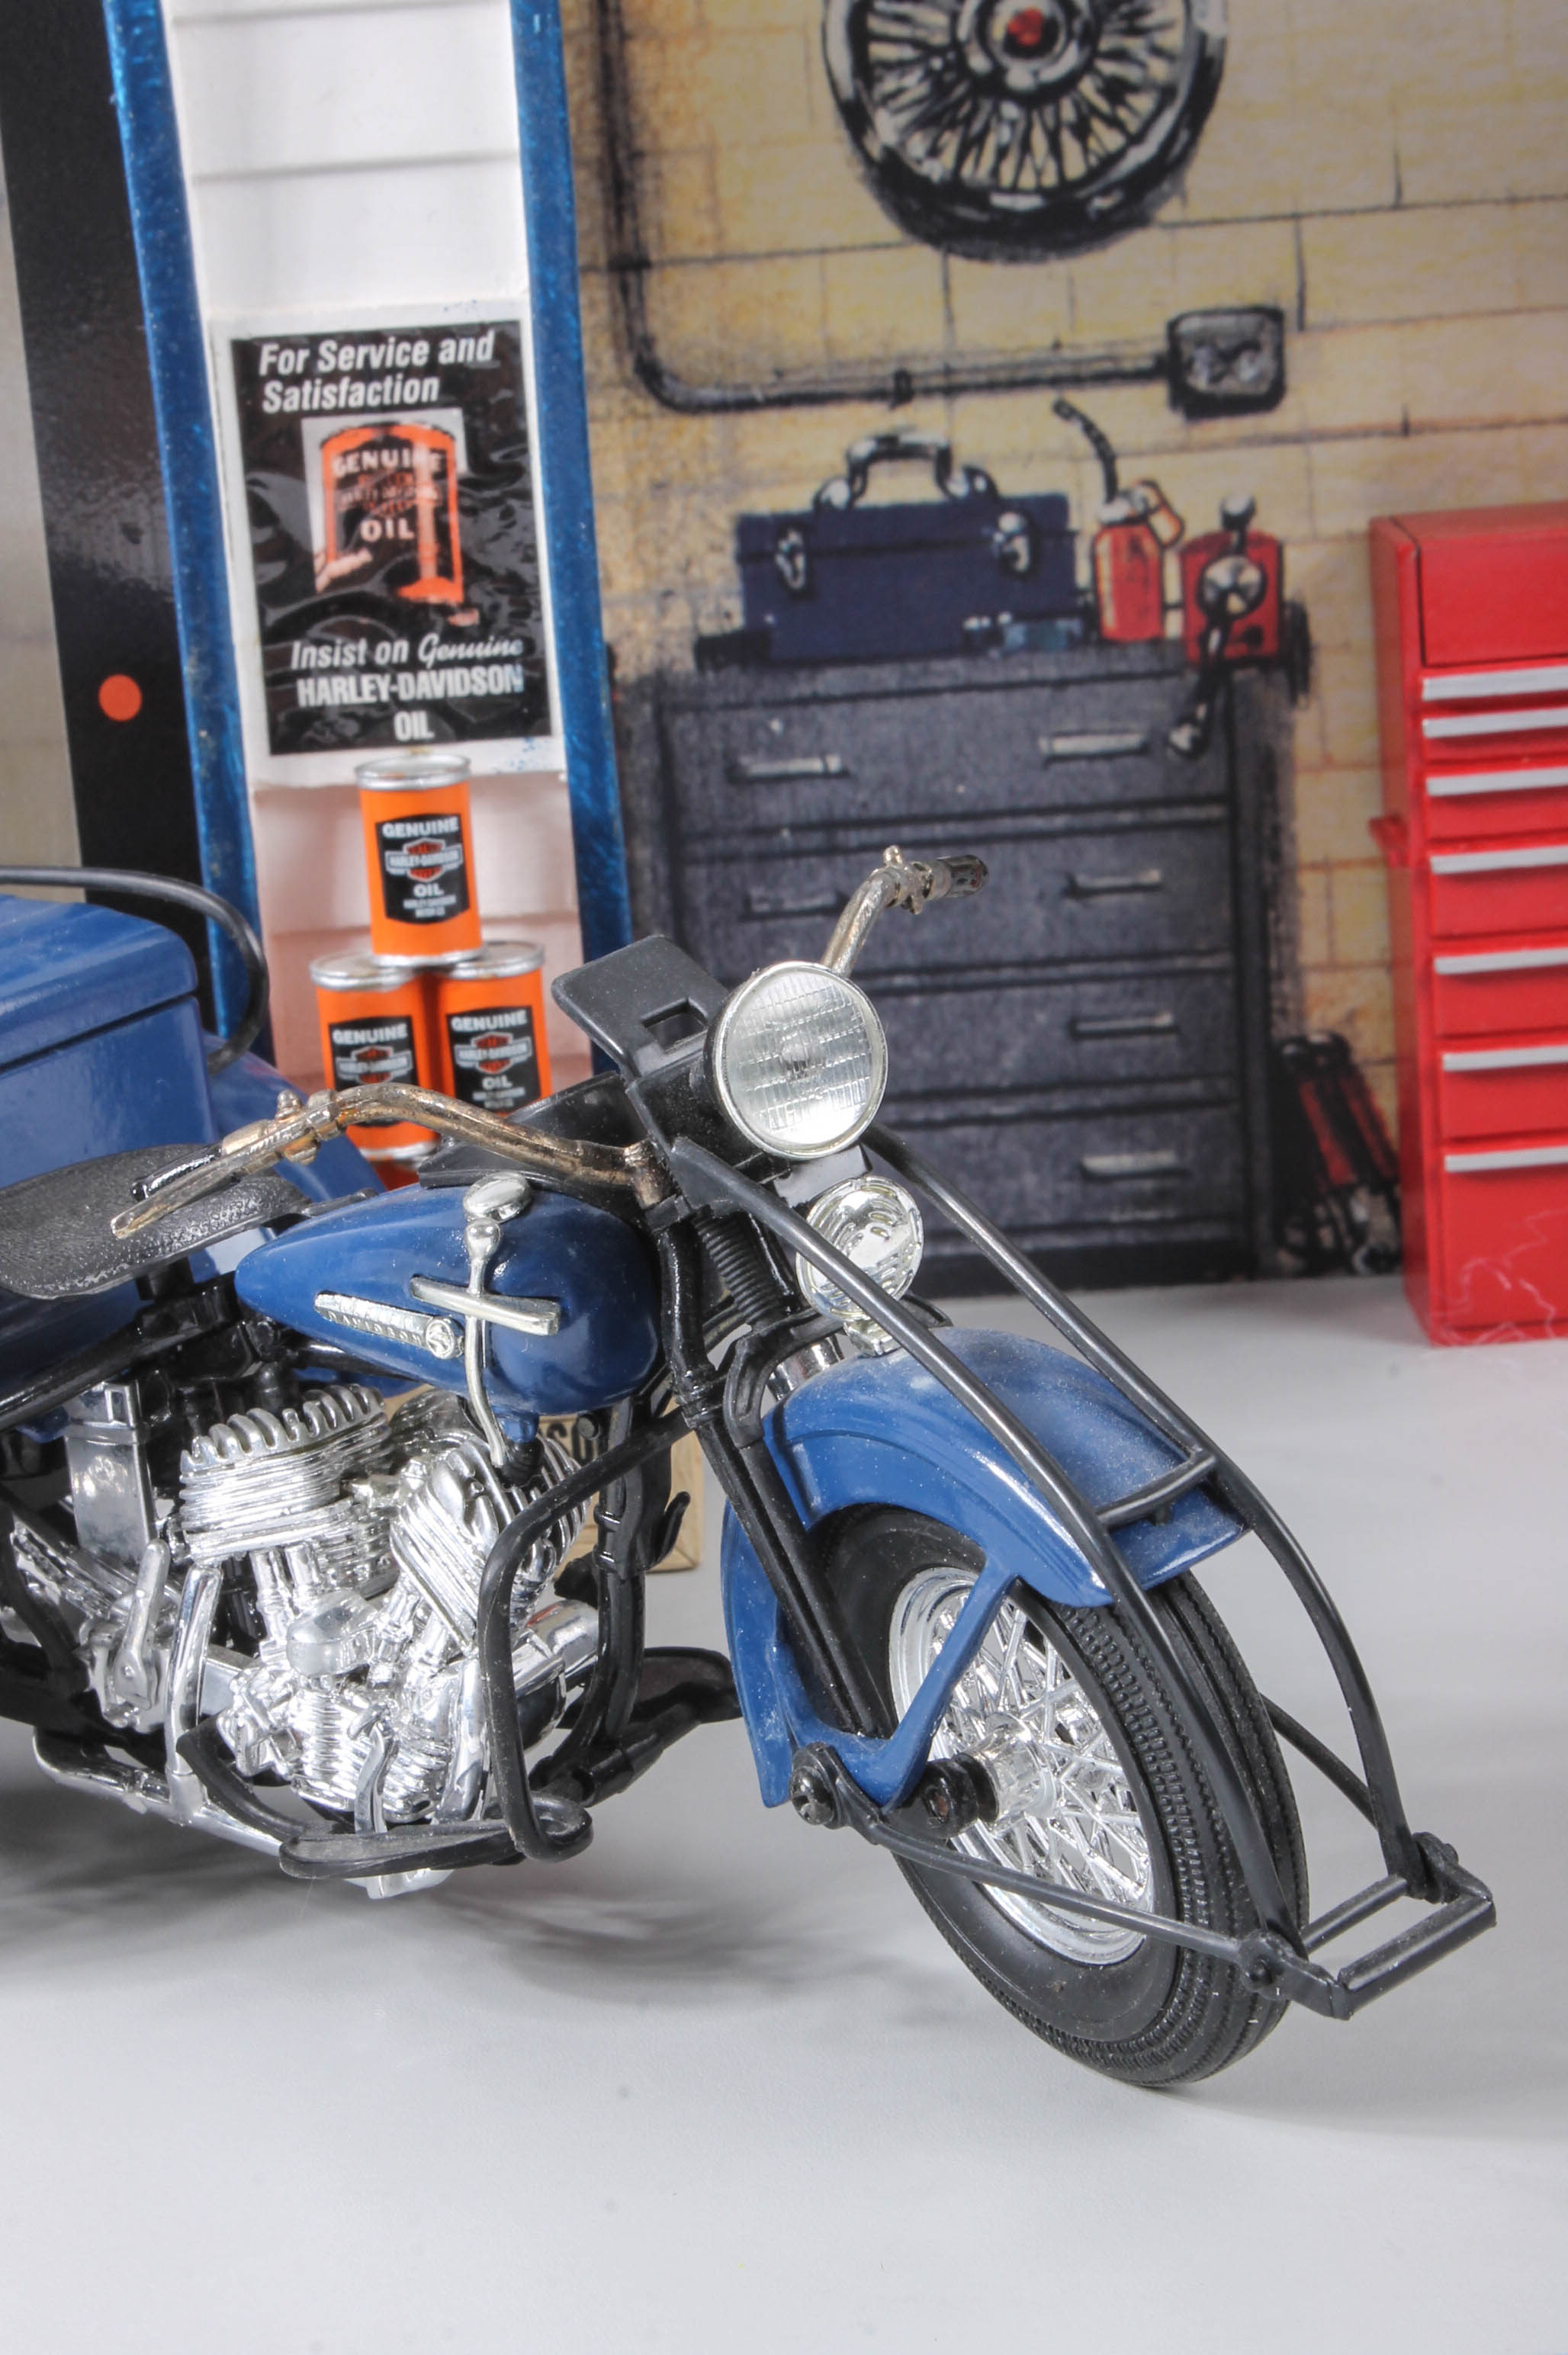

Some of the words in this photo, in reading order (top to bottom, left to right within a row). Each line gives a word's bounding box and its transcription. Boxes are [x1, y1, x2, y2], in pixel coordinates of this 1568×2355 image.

[259, 342, 310, 377] For
[317, 336, 430, 374] Service
[438, 329, 496, 365] and
[262, 372, 440, 413] Satisfaction
[359, 518, 416, 542] OIL
[291, 636, 368, 670] Insist
[374, 638, 410, 665] on
[418, 633, 523, 669] Genuine
[297, 664, 524, 708] HARLEY-DAVIDSON
[394, 711, 435, 742] OIL
[382, 816, 460, 838] GENUINE
[413, 883, 445, 898] OIL
[451, 1009, 528, 1031] GENUINE
[332, 1023, 408, 1045] GENUINE
[482, 1075, 513, 1091] OIL
